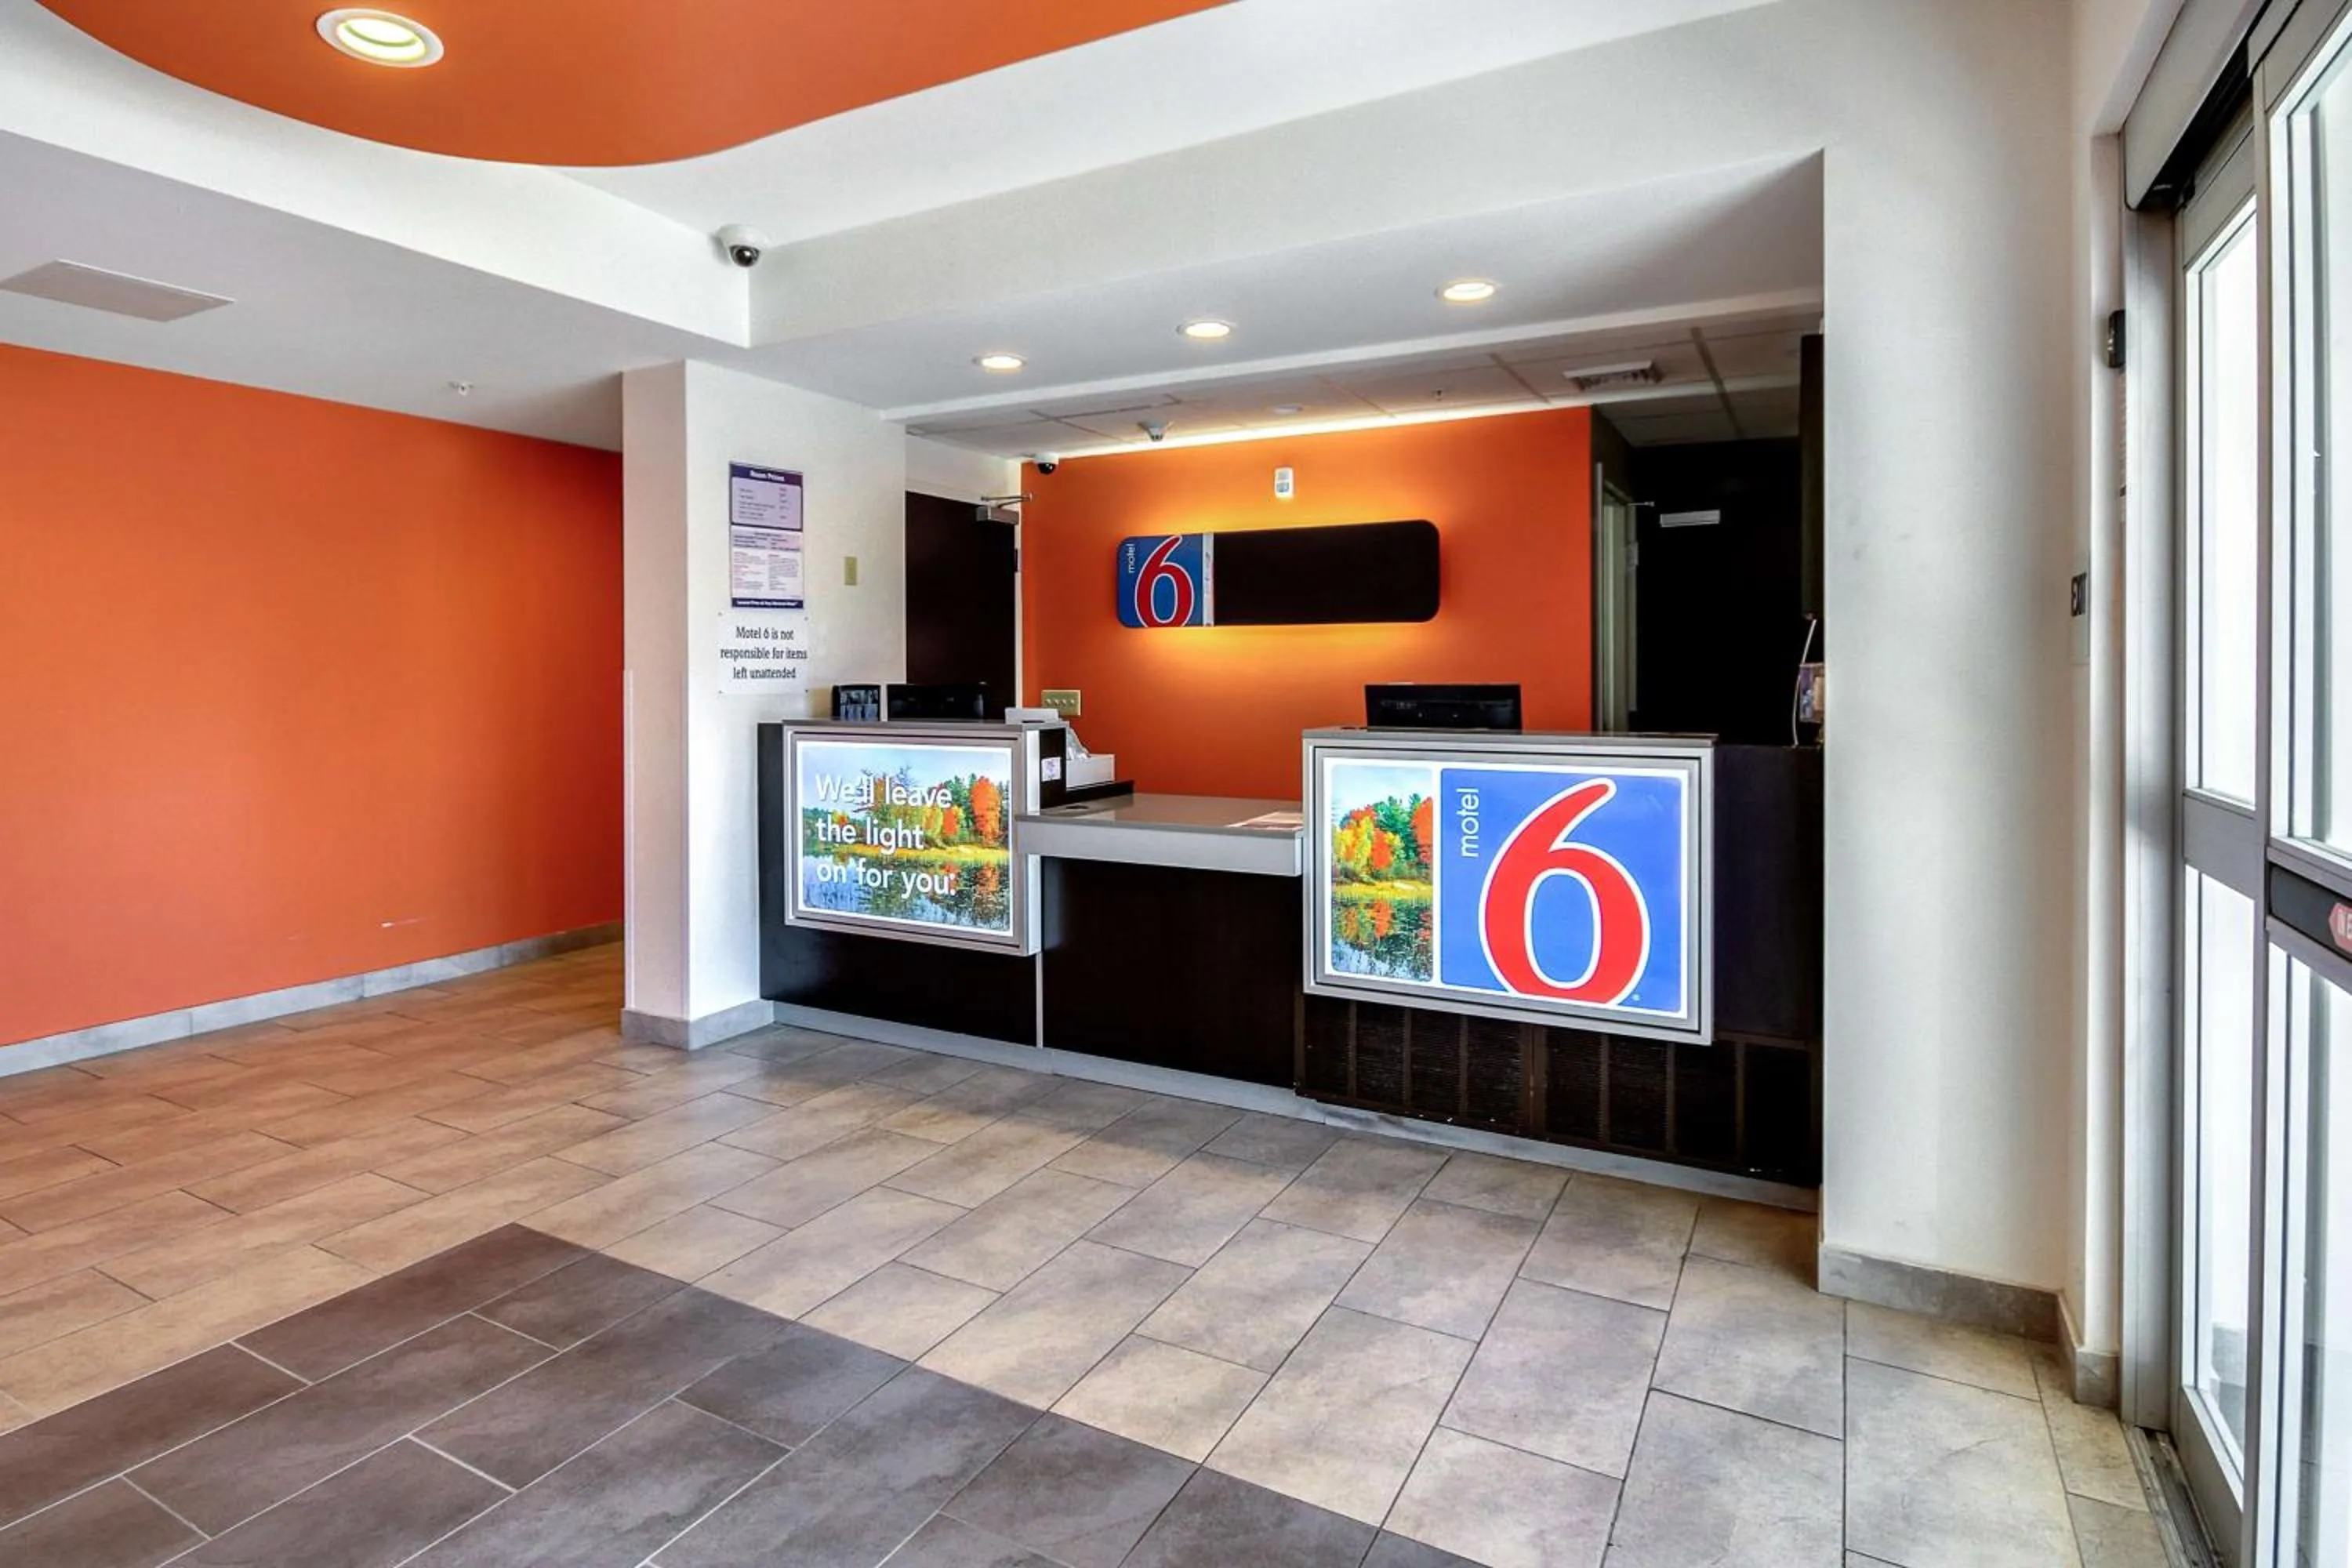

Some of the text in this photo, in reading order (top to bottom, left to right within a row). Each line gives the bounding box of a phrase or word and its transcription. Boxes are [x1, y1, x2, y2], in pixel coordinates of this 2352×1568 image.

[1126, 543, 1135, 573] motel
[1134, 535, 1195, 628] 6
[735, 626, 794, 641] Motel 6 is not
[720, 646, 808, 662] responsible for items
[733, 666, 797, 680] left unattended
[885, 776, 953, 808] leave
[815, 812, 924, 855] the light
[1456, 787, 1479, 858] motel
[816, 863, 847, 884] on
[856, 858, 893, 889] for
[1479, 777, 1650, 1007] 6
